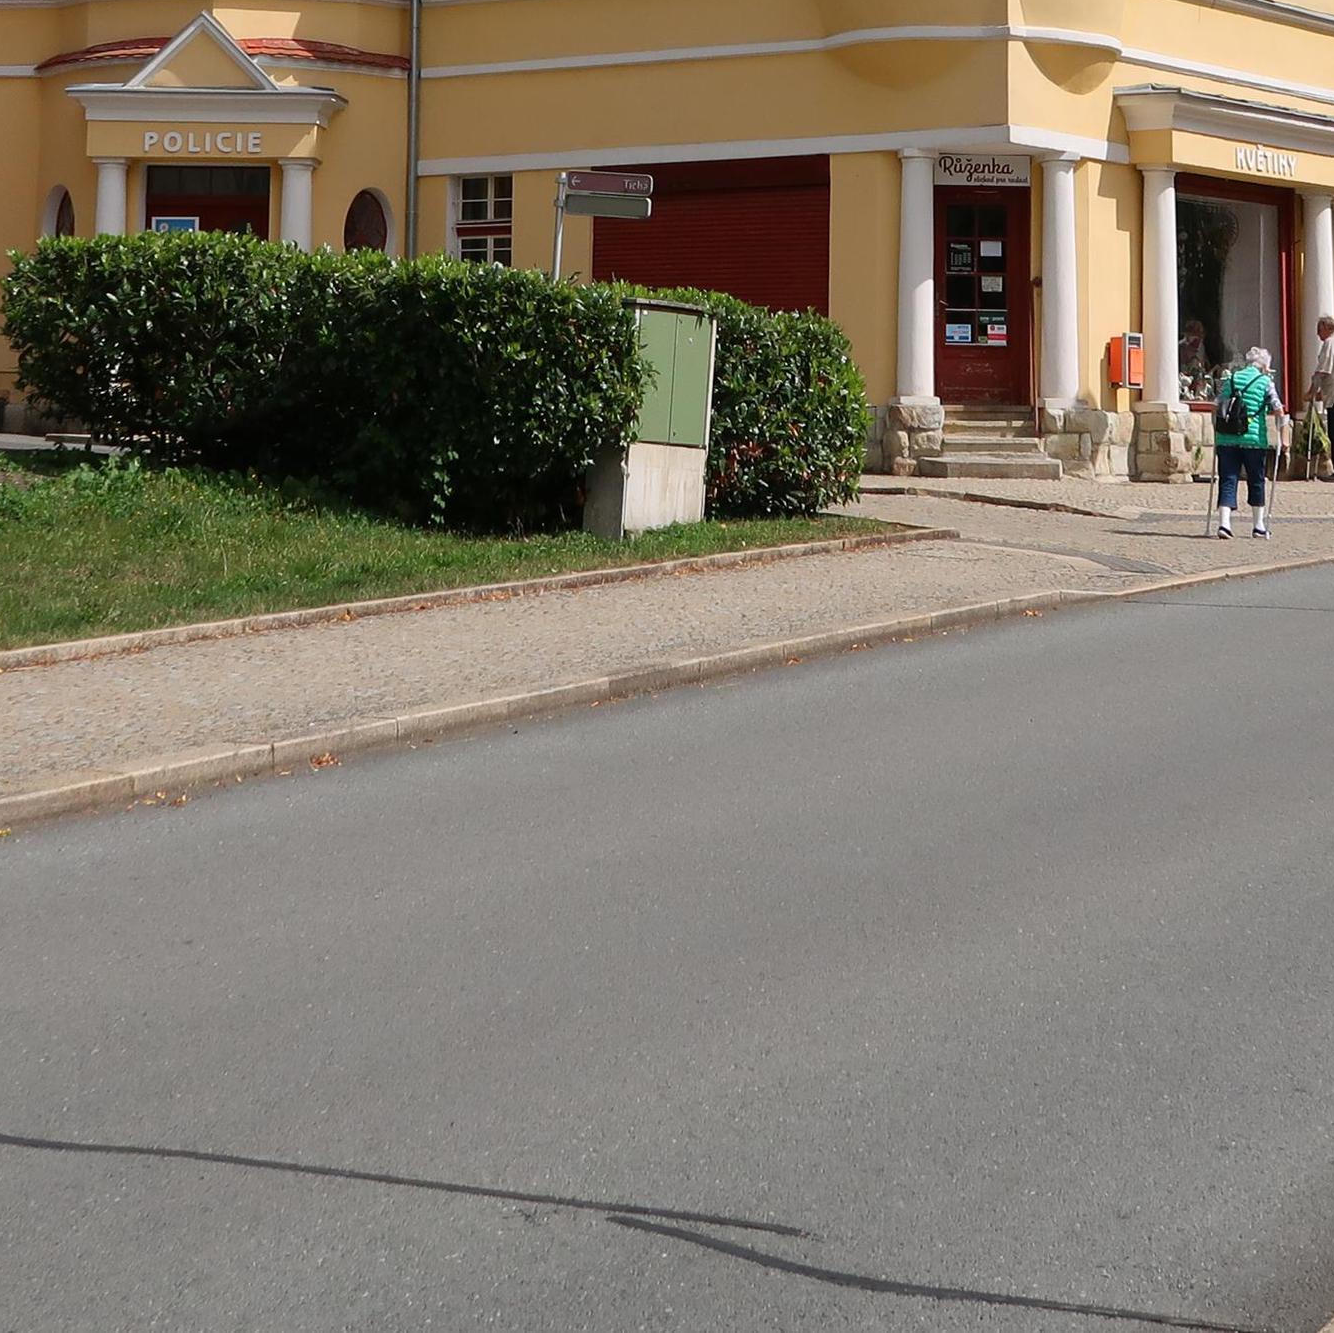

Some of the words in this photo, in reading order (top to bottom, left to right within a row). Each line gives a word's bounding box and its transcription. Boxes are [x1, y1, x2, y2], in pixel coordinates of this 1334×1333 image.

[144, 131, 262, 153] POLICIE
[939, 155, 1014, 182] Růženka
[1235, 144, 1298, 177] KVĚTINY
